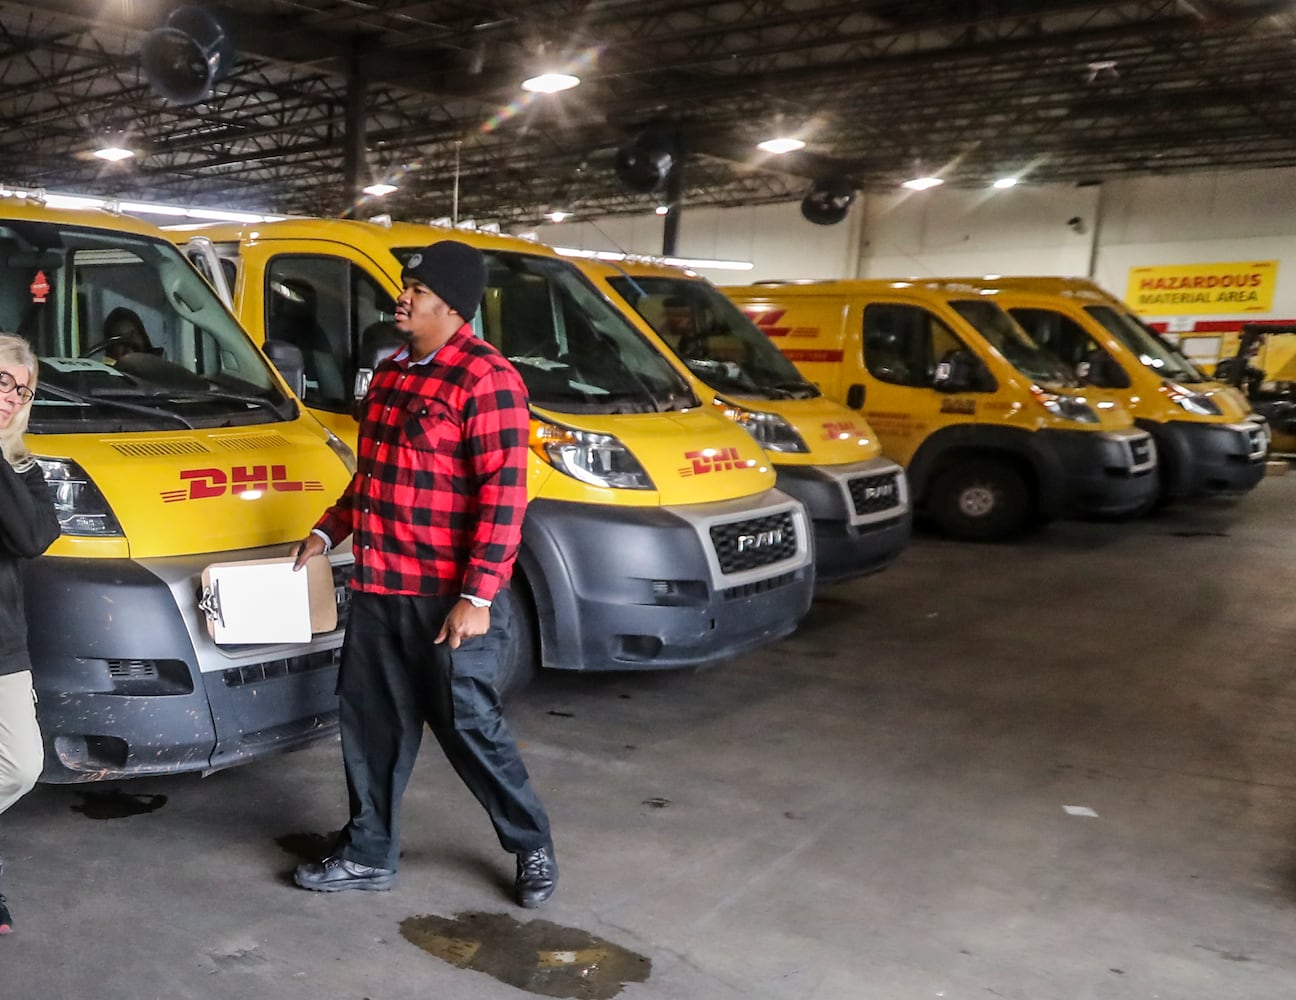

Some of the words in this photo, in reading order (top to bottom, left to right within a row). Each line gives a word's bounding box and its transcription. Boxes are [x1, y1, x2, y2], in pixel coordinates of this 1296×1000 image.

[1139, 273, 1262, 290] HAZARDOUS
[1139, 291, 1212, 305] MATERIAL
[1216, 290, 1257, 303] AREA
[685, 447, 756, 475] DHL
[180, 465, 303, 499] DHL
